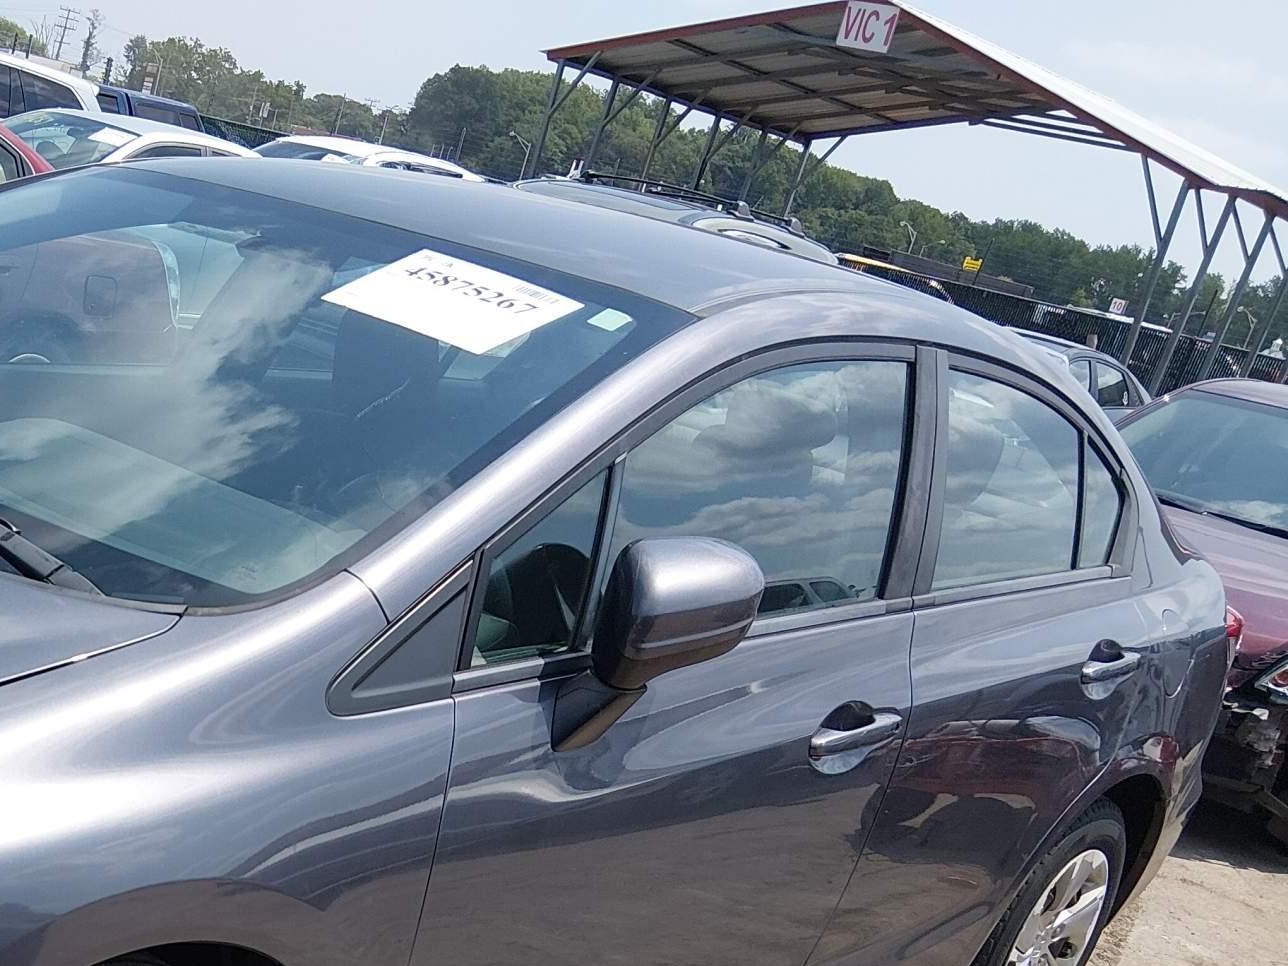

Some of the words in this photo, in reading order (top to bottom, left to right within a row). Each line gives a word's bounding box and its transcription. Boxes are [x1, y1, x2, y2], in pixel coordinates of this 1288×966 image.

[844, 6, 880, 43] VIC
[884, 14, 897, 46] 1
[405, 266, 539, 314] 45875267
